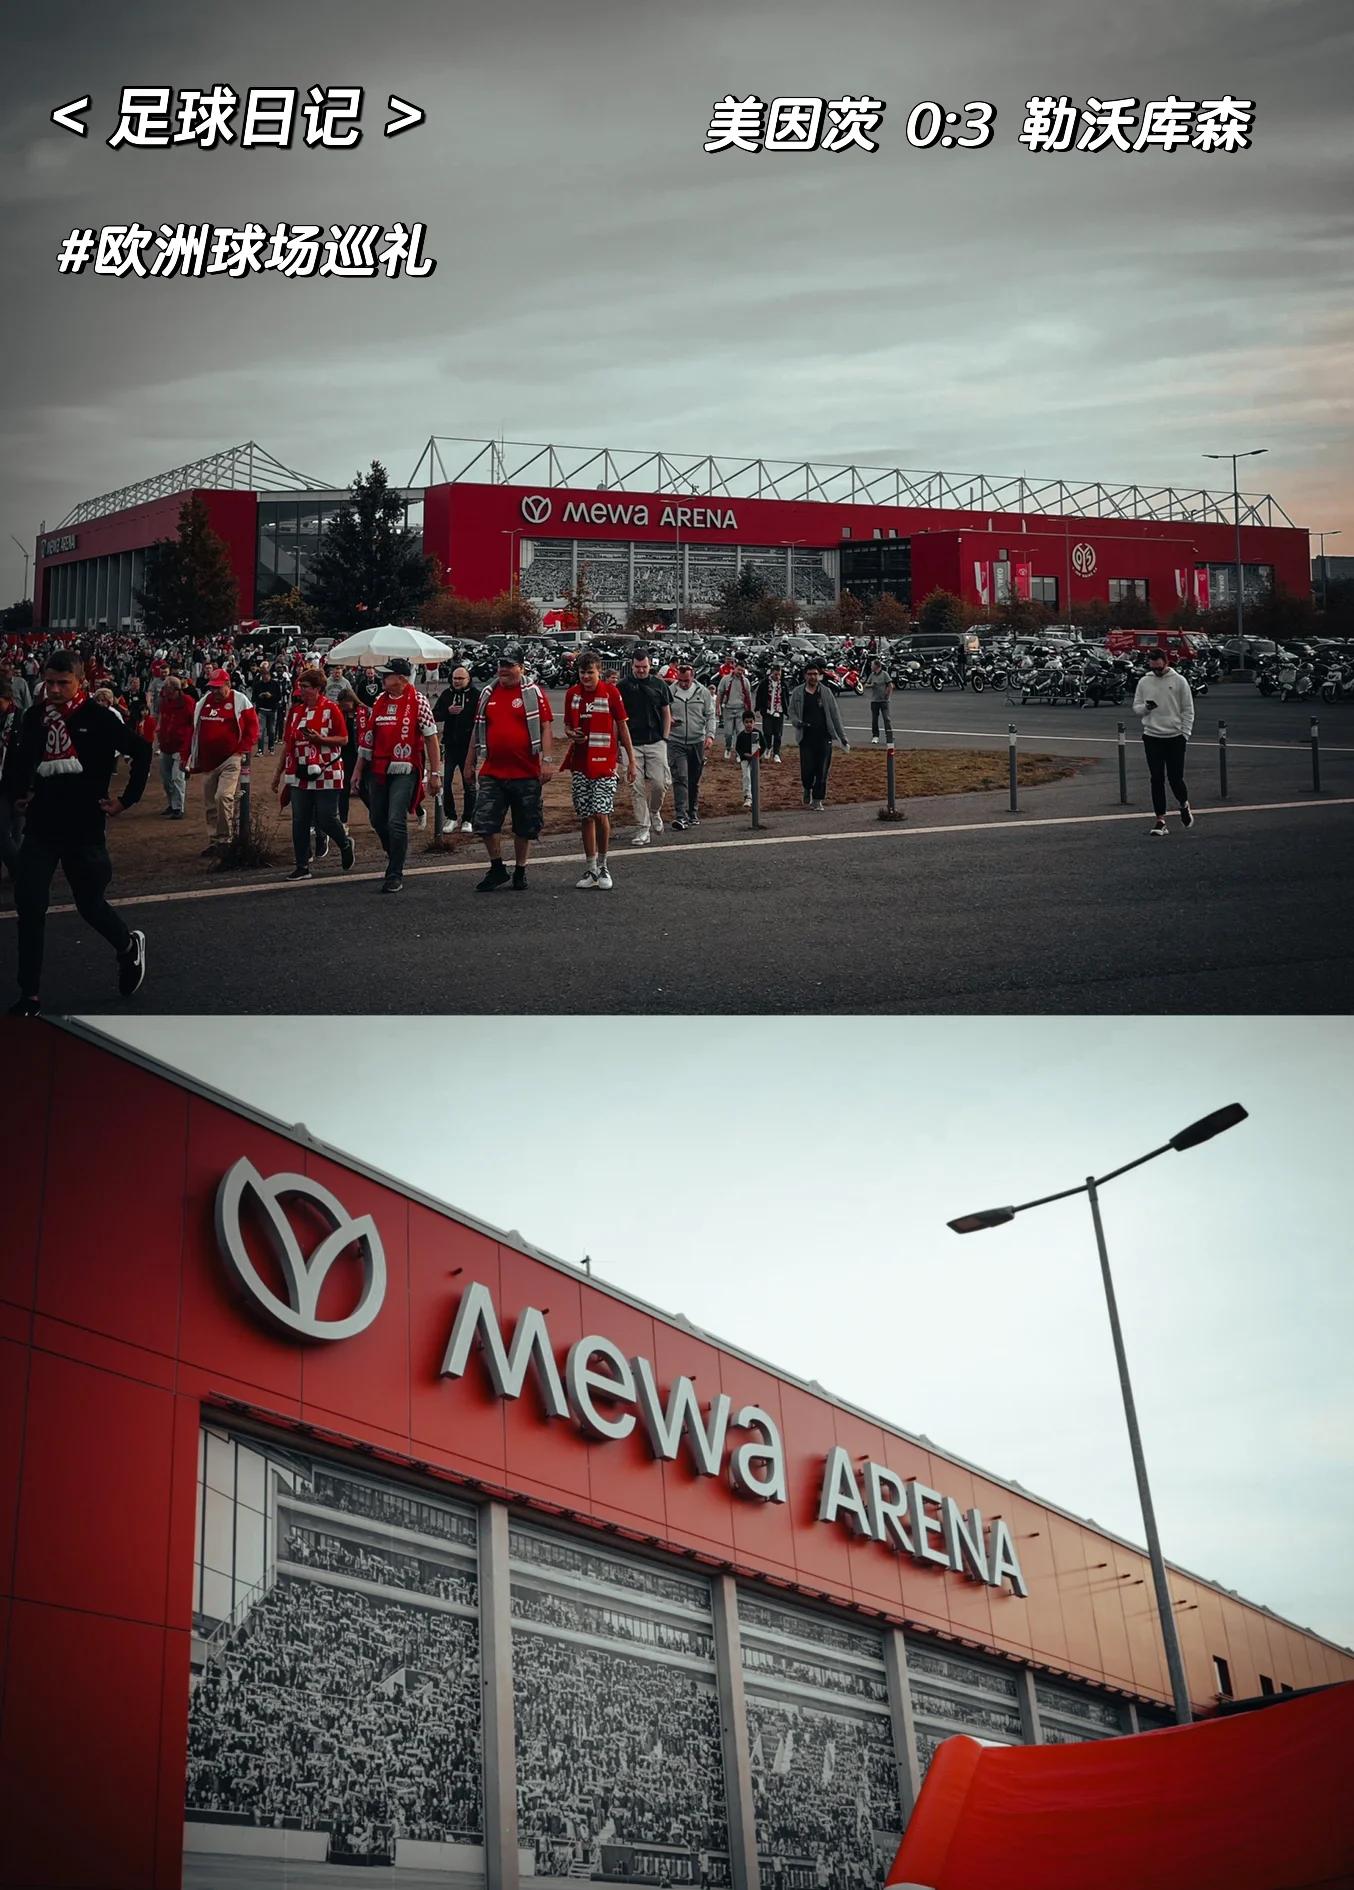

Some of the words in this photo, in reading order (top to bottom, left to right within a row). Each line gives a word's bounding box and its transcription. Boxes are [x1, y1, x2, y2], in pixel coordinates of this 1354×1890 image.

[659, 506, 738, 529] ARENA
[401, 704, 411, 740] 100%
[818, 1445, 1029, 1599] ARENA
